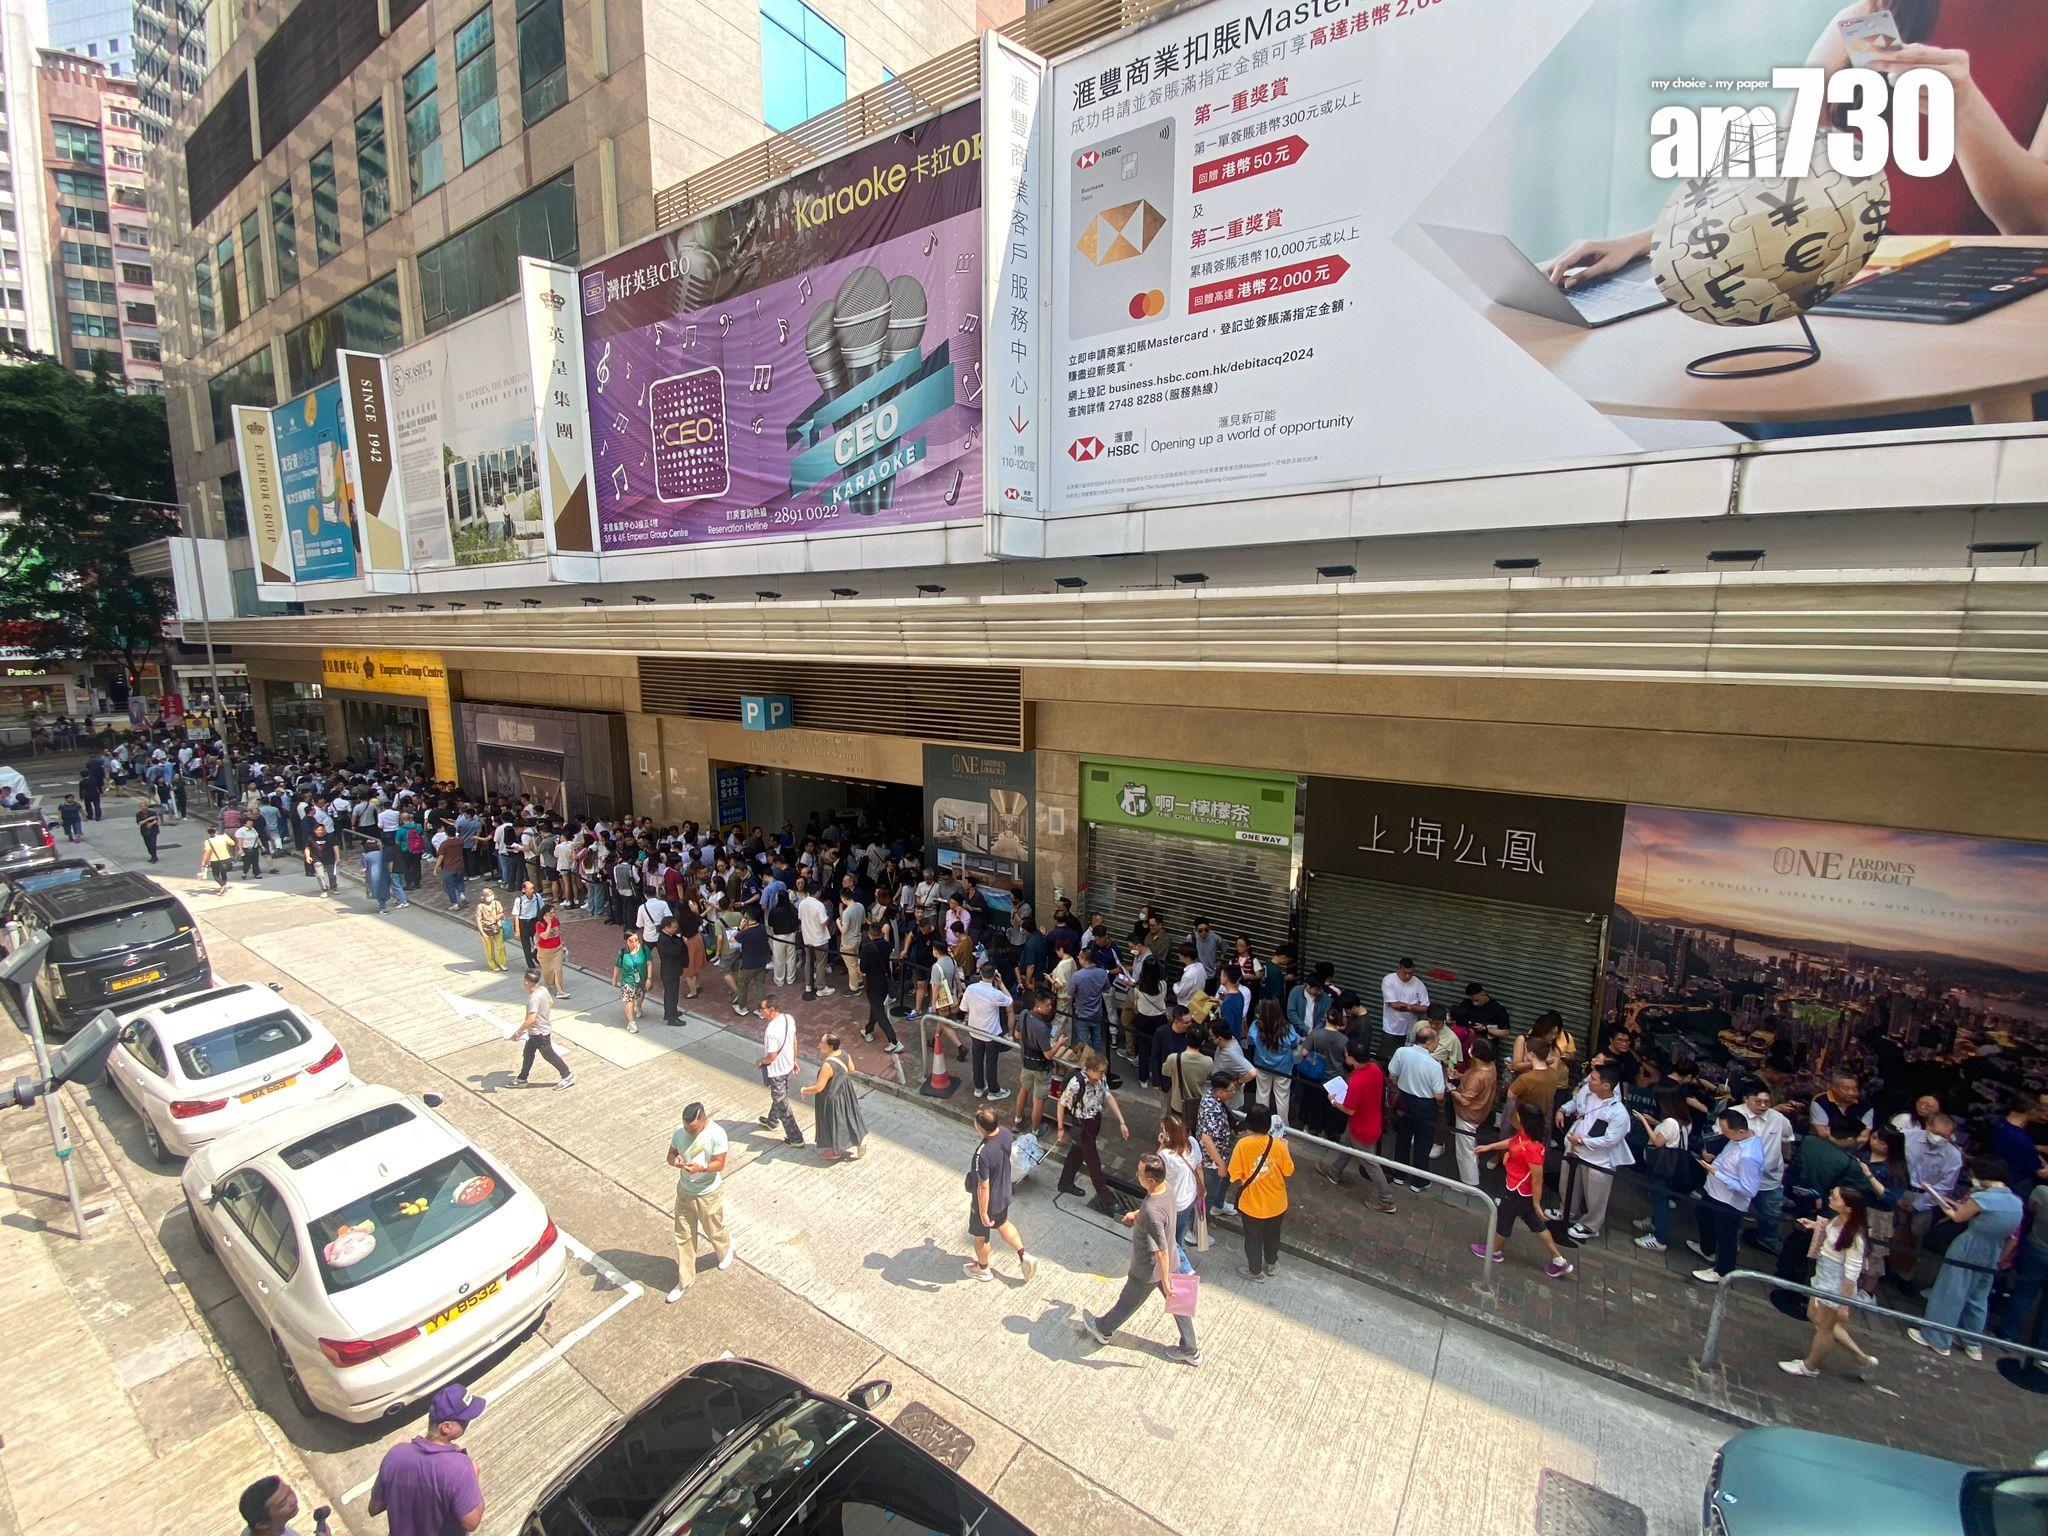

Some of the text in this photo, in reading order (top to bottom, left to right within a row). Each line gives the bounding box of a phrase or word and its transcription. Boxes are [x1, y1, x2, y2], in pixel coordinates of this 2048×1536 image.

[1194, 76, 1289, 127] 第一重獎賞
[1101, 145, 1122, 158] HSBC
[795, 163, 907, 232] Karaoke
[1192, 204, 1204, 219] 及
[1190, 207, 1283, 250] 第二重獎賞
[548, 326, 573, 440] 英皇集團
[1068, 347, 1314, 402] 網上登記 business.hsbc.com.hk/debitacq2024
[1108, 397, 1134, 411] 2748
[1136, 392, 1163, 406] 8288
[360, 379, 383, 463] SINCE 1942
[663, 417, 713, 447] CEO
[835, 403, 899, 466] CEO
[1150, 413, 1355, 453] Opening up a world of opportunity
[1107, 442, 1140, 458] HSBC
[832, 445, 917, 504] KARAOKE
[254, 444, 279, 543] EMPEROR GROUP
[807, 505, 839, 521] 0022
[650, 529, 668, 540] Group
[669, 528, 689, 538] Centre
[708, 521, 769, 535] Reservation Hotline
[403, 664, 422, 680] Group
[423, 665, 444, 678] Centre
[746, 702, 785, 725] P P
[952, 753, 979, 774] ONE
[720, 777, 739, 788] $32
[1156, 811, 1250, 829] THE ONE LEMON TEA
[1241, 832, 1281, 844] ONE WAY
[1773, 846, 1842, 880] ONE
[1849, 856, 1916, 875] JARDINE'S
[1847, 868, 1914, 887] LOOKOUT
[1701, 879, 1770, 895] EXQUISITE
[1778, 889, 1852, 905] LIFESTYLE
